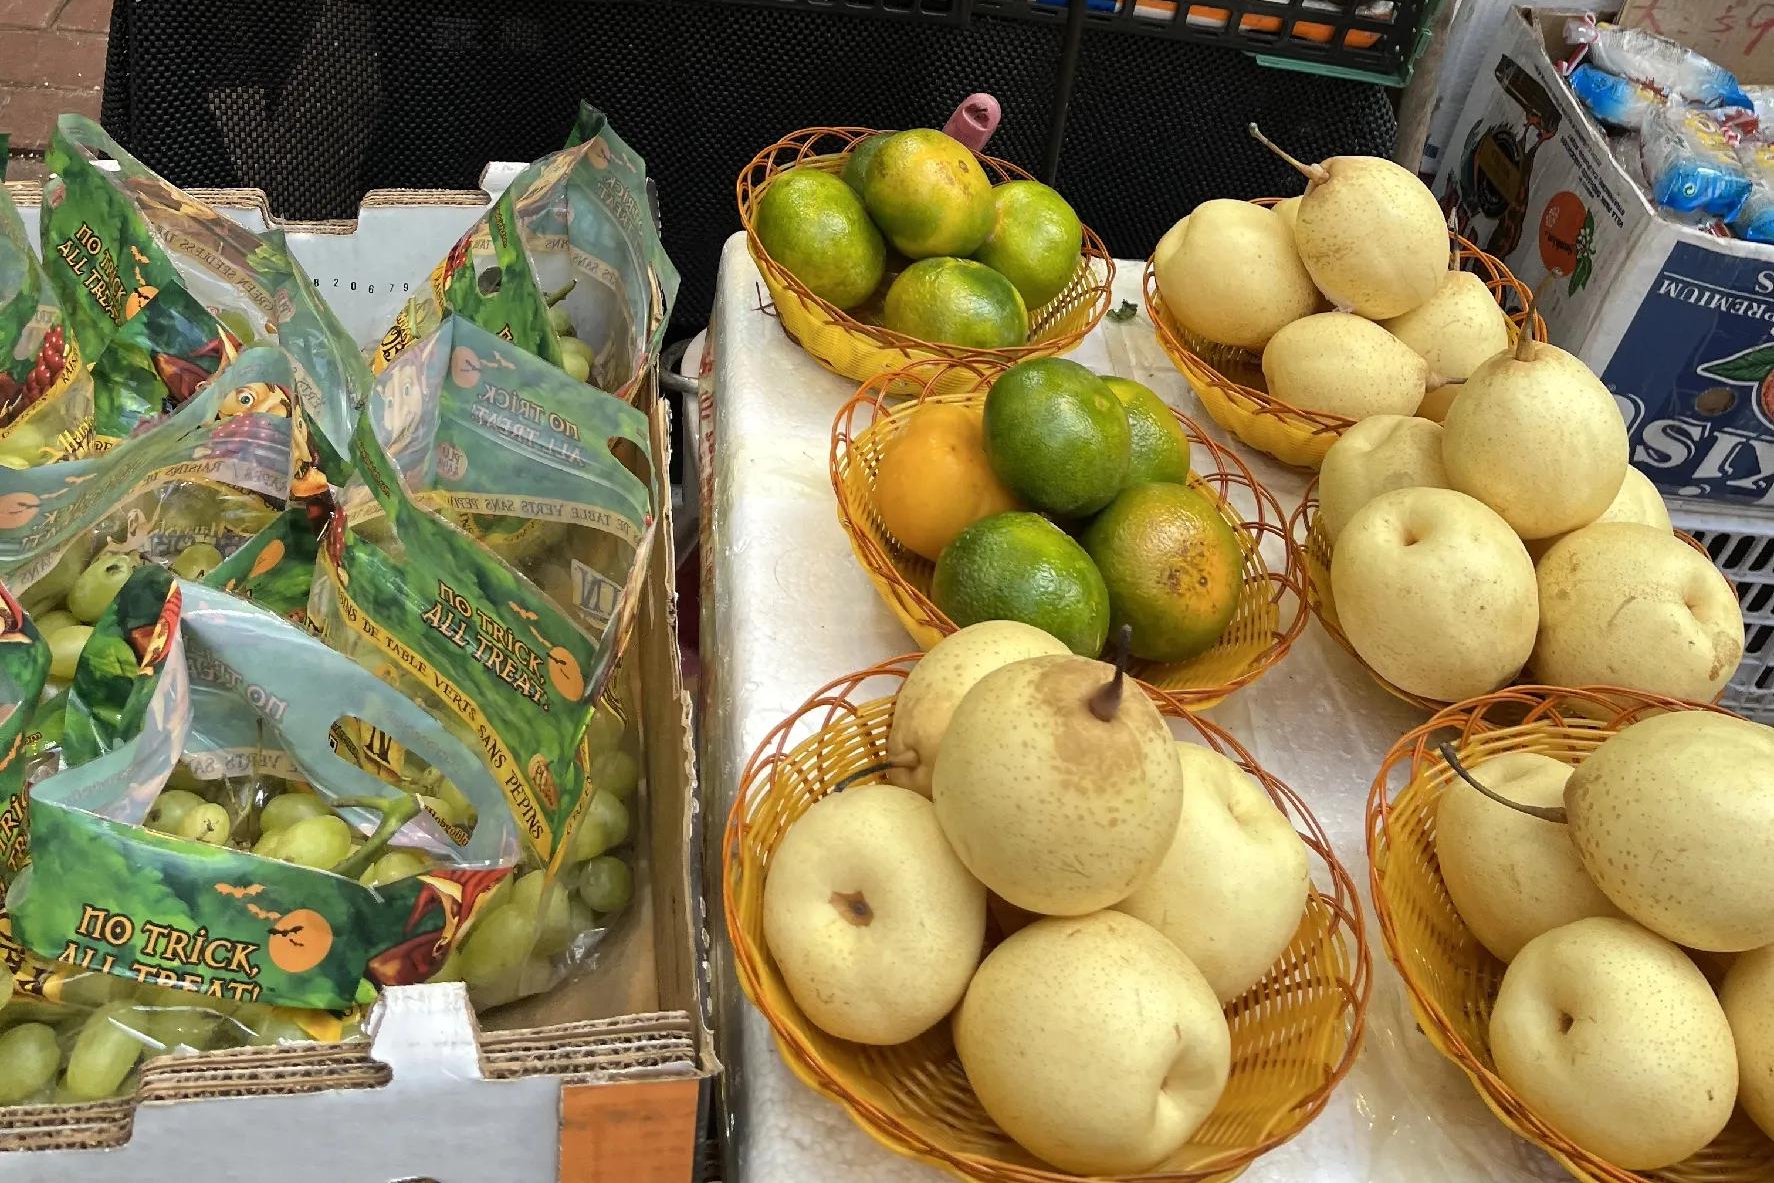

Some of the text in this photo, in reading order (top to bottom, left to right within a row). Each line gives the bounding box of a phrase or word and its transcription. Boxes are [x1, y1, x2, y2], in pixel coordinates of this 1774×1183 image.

[57, 239, 84, 276] ALL
[421, 601, 468, 650] ALL
[384, 636, 427, 675] TABLE
[433, 671, 478, 722] VERTS
[476, 724, 508, 770] SANS
[504, 768, 545, 840] PEPINS
[138, 920, 262, 978] TRICK,
